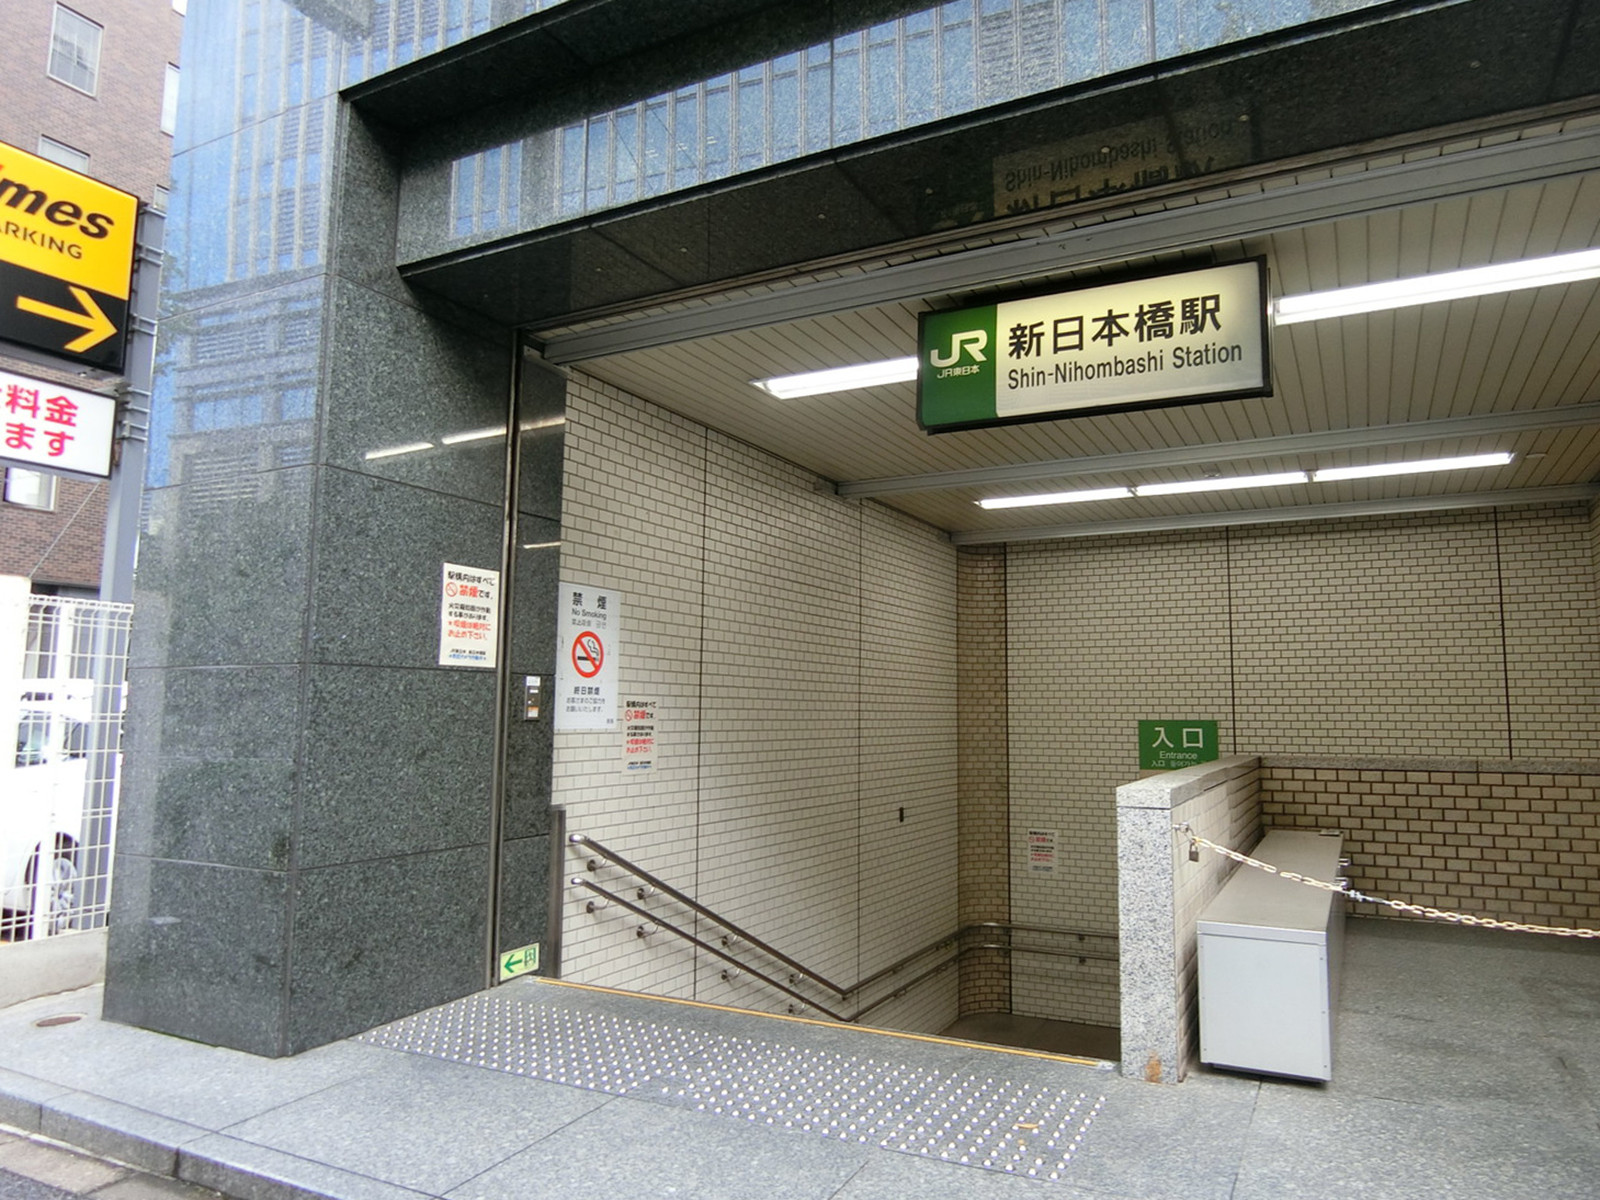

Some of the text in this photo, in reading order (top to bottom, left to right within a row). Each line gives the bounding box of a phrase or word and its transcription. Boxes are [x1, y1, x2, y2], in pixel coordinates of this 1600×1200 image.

[0, 177, 115, 240] mes
[0, 220, 83, 260] RKING
[1008, 293, 1222, 361] 新日本橋駅
[930, 329, 988, 368] JR
[1008, 342, 1243, 390] Shin-Nihombashi Station
[936, 364, 980, 379] JR東日本
[0, 384, 78, 428] 料金
[5, 422, 75, 457] ます
[571, 608, 607, 621] No Smoking
[1152, 726, 1204, 749] 入口
[1159, 750, 1198, 760] Entrance
